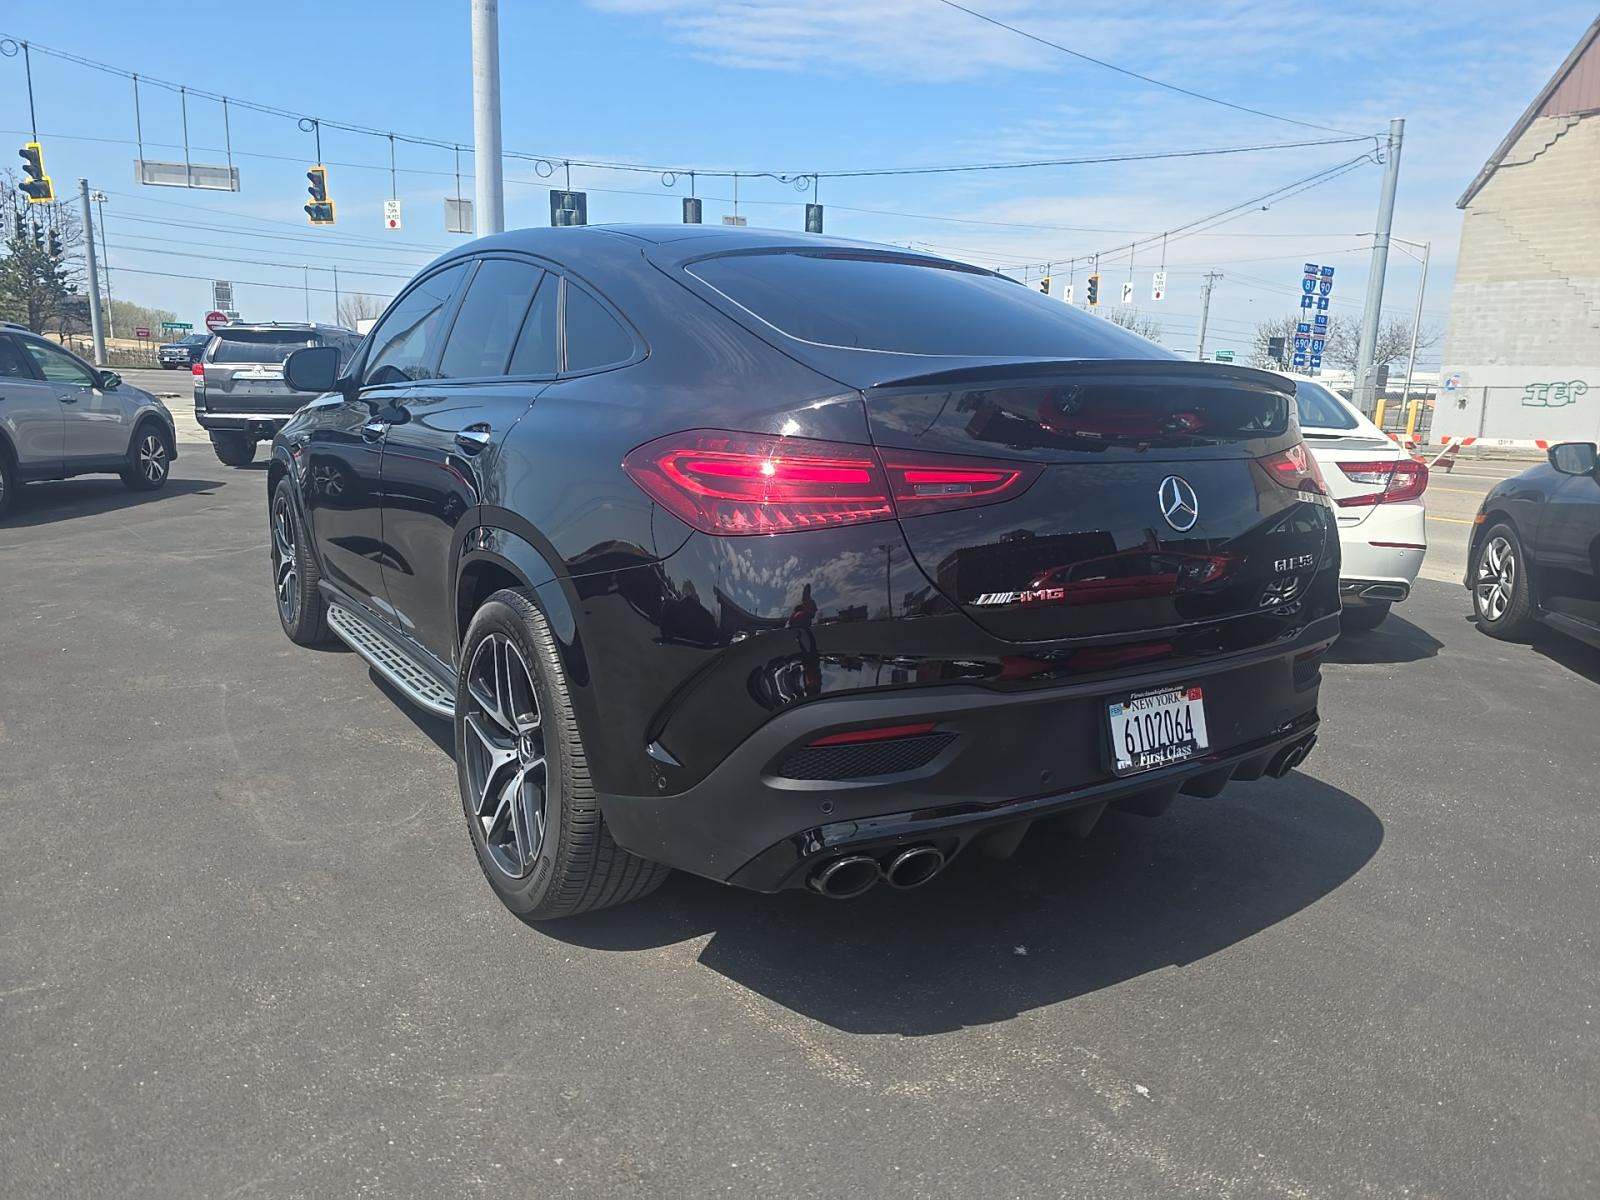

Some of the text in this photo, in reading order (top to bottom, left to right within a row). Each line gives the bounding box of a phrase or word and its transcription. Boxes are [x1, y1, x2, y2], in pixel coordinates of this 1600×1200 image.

[1306, 280, 1314, 291] 81
[1320, 282, 1330, 292] 90
[1295, 339, 1309, 348] 690
[1313, 340, 1322, 350] 81
[1131, 697, 1155, 711] NEW
[1156, 691, 1180, 706] YORK
[1125, 705, 1194, 754] 6102064
[1140, 748, 1166, 767] First
[1167, 745, 1192, 760] Class
